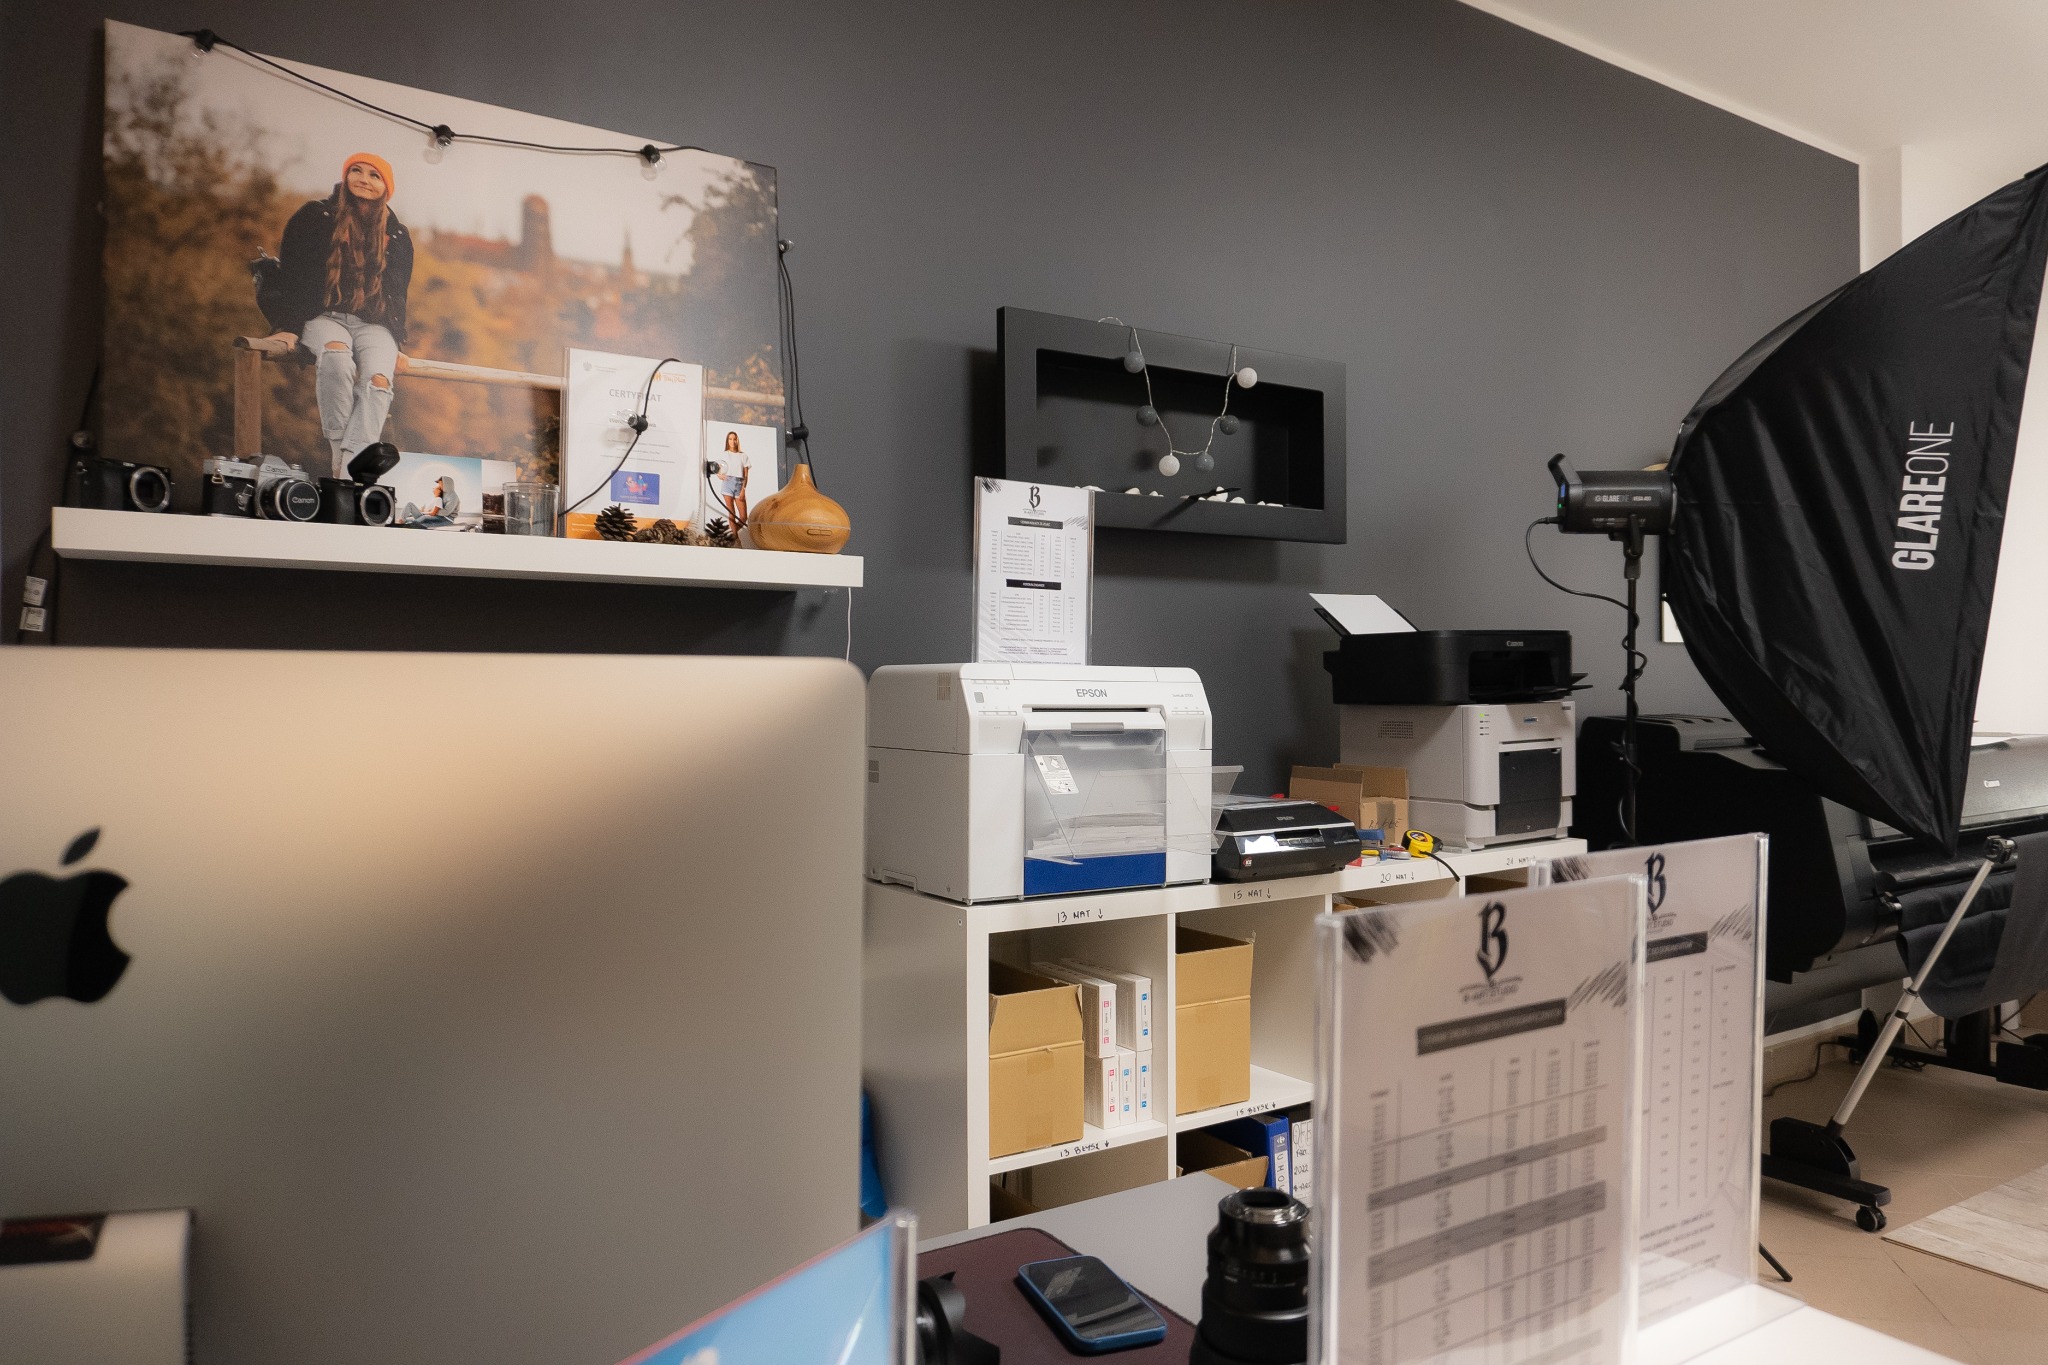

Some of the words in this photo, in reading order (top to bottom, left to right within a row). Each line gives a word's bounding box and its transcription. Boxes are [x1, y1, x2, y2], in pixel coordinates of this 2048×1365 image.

[265, 465, 288, 473] Canon
[1891, 421, 1954, 571] GLAREONE
[1076, 689, 1107, 698] EPSON
[1380, 873, 1391, 883] 20
[1233, 890, 1242, 900] 15
[1248, 889, 1263, 897] MAT
[1057, 911, 1067, 923] 13
[1073, 909, 1090, 919] MAT
[1060, 1149, 1070, 1157] 13
